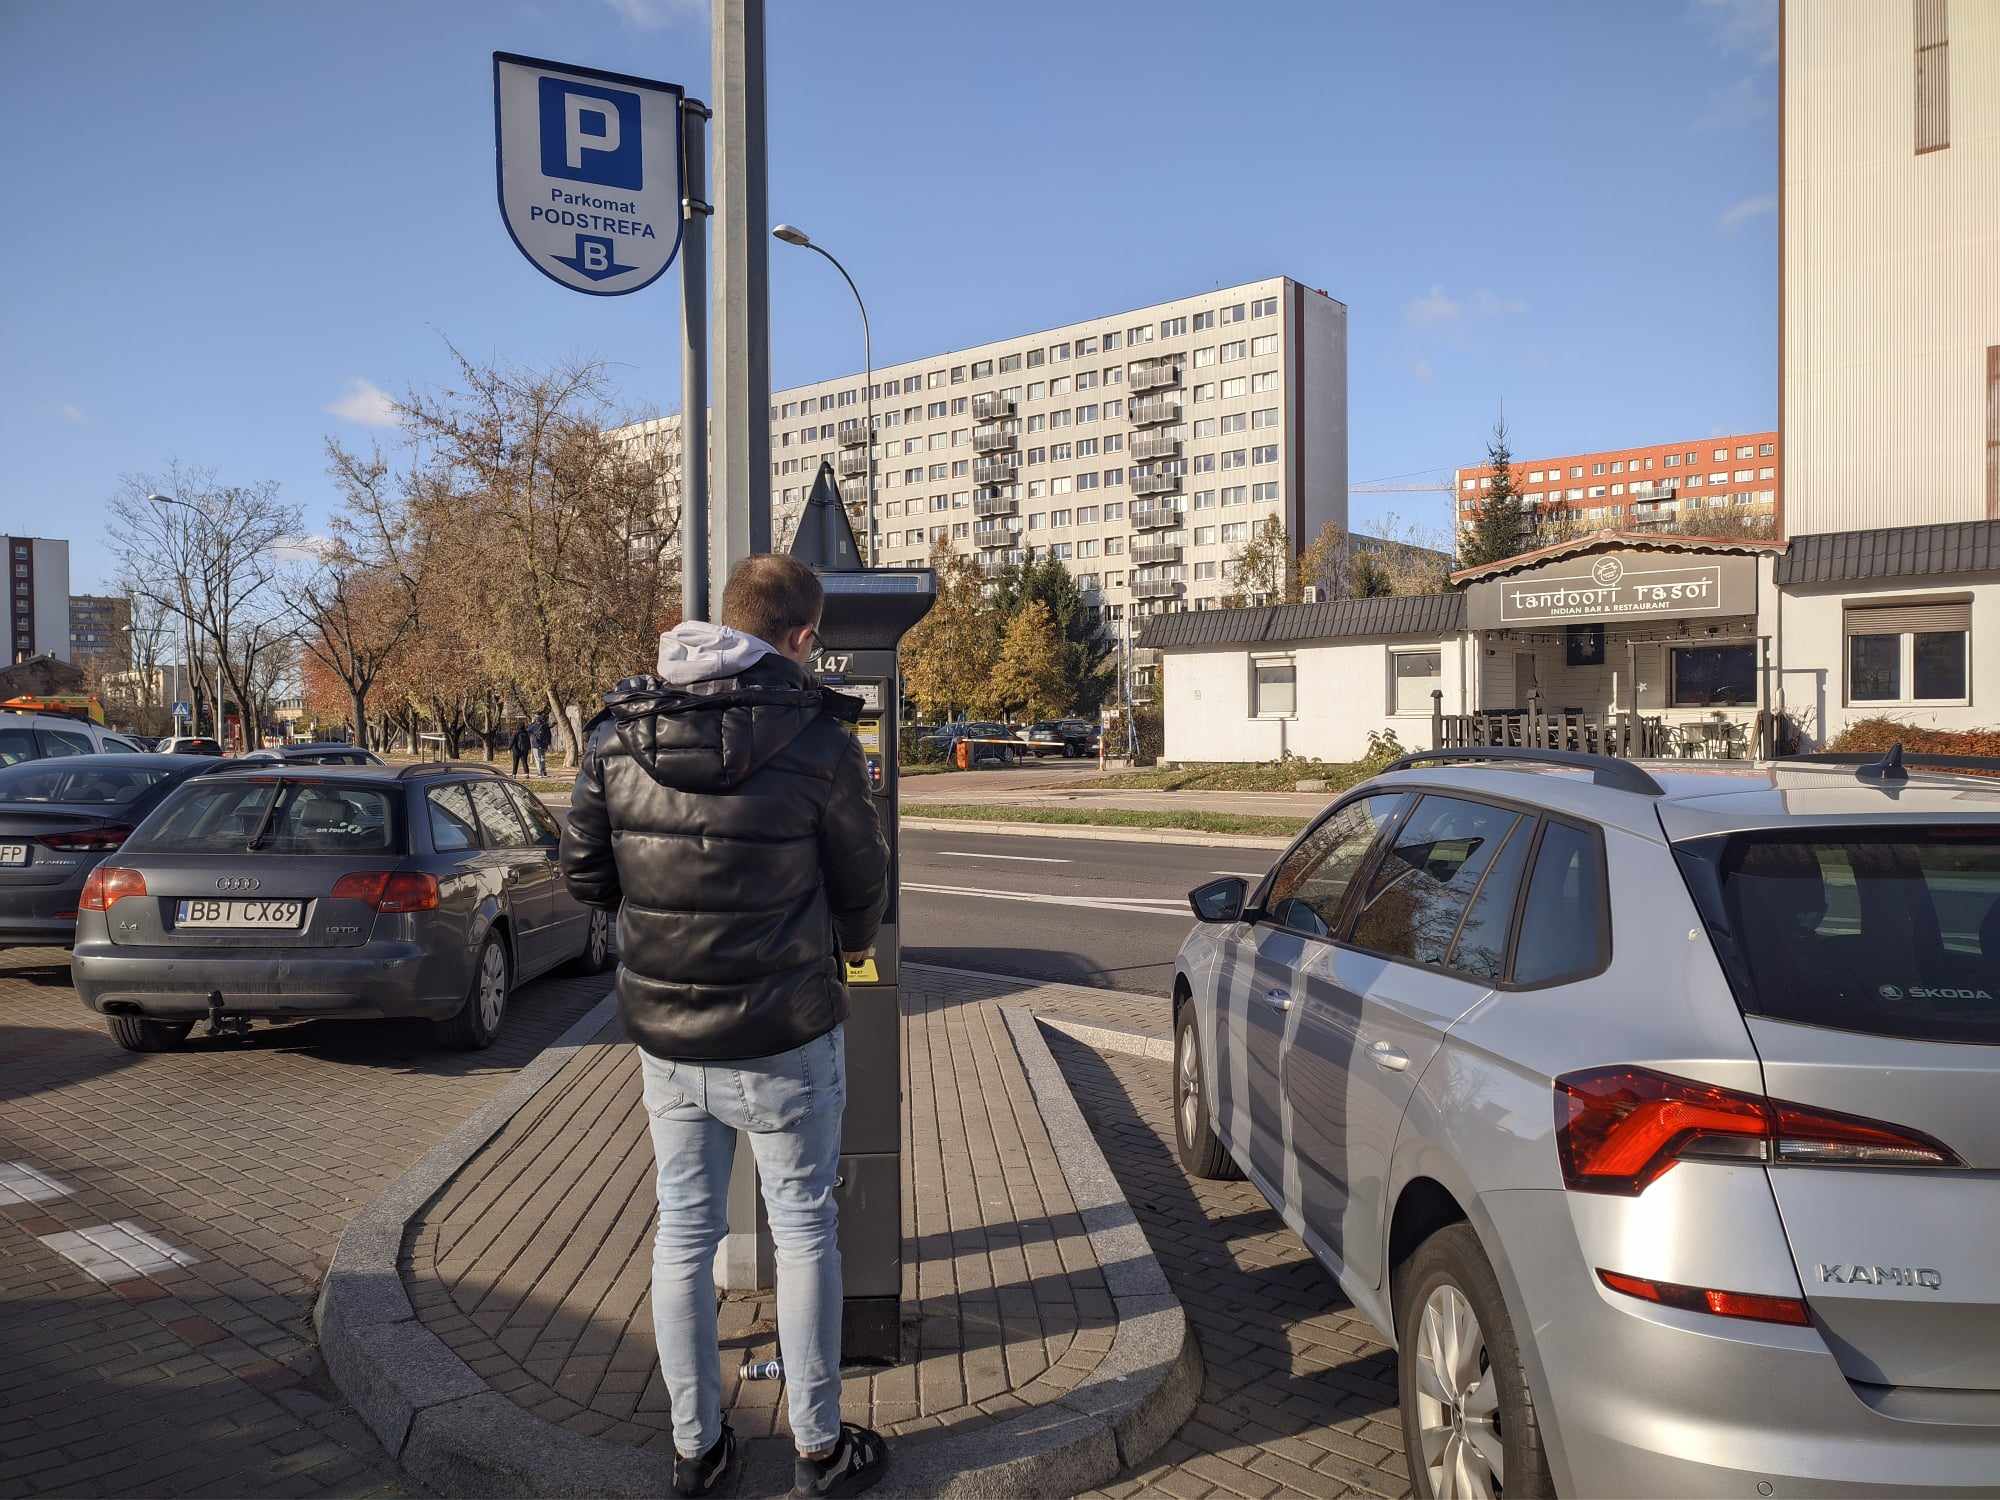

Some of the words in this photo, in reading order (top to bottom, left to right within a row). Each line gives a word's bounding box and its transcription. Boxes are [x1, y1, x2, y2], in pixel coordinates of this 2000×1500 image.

[564, 92, 620, 168] P
[551, 188, 636, 214] Parkomat
[530, 206, 656, 239] PODSTREFA
[583, 241, 608, 271] B
[1510, 583, 1621, 609] tandoori
[1633, 577, 1712, 601] rasoi
[1551, 607, 1582, 616] INDIAN
[1584, 605, 1602, 613] BAR
[1613, 601, 1670, 612] RESTAURANT
[814, 656, 849, 672] 147
[243, 902, 298, 922] CX69
[1819, 1263, 1941, 1290] KAMIQ
